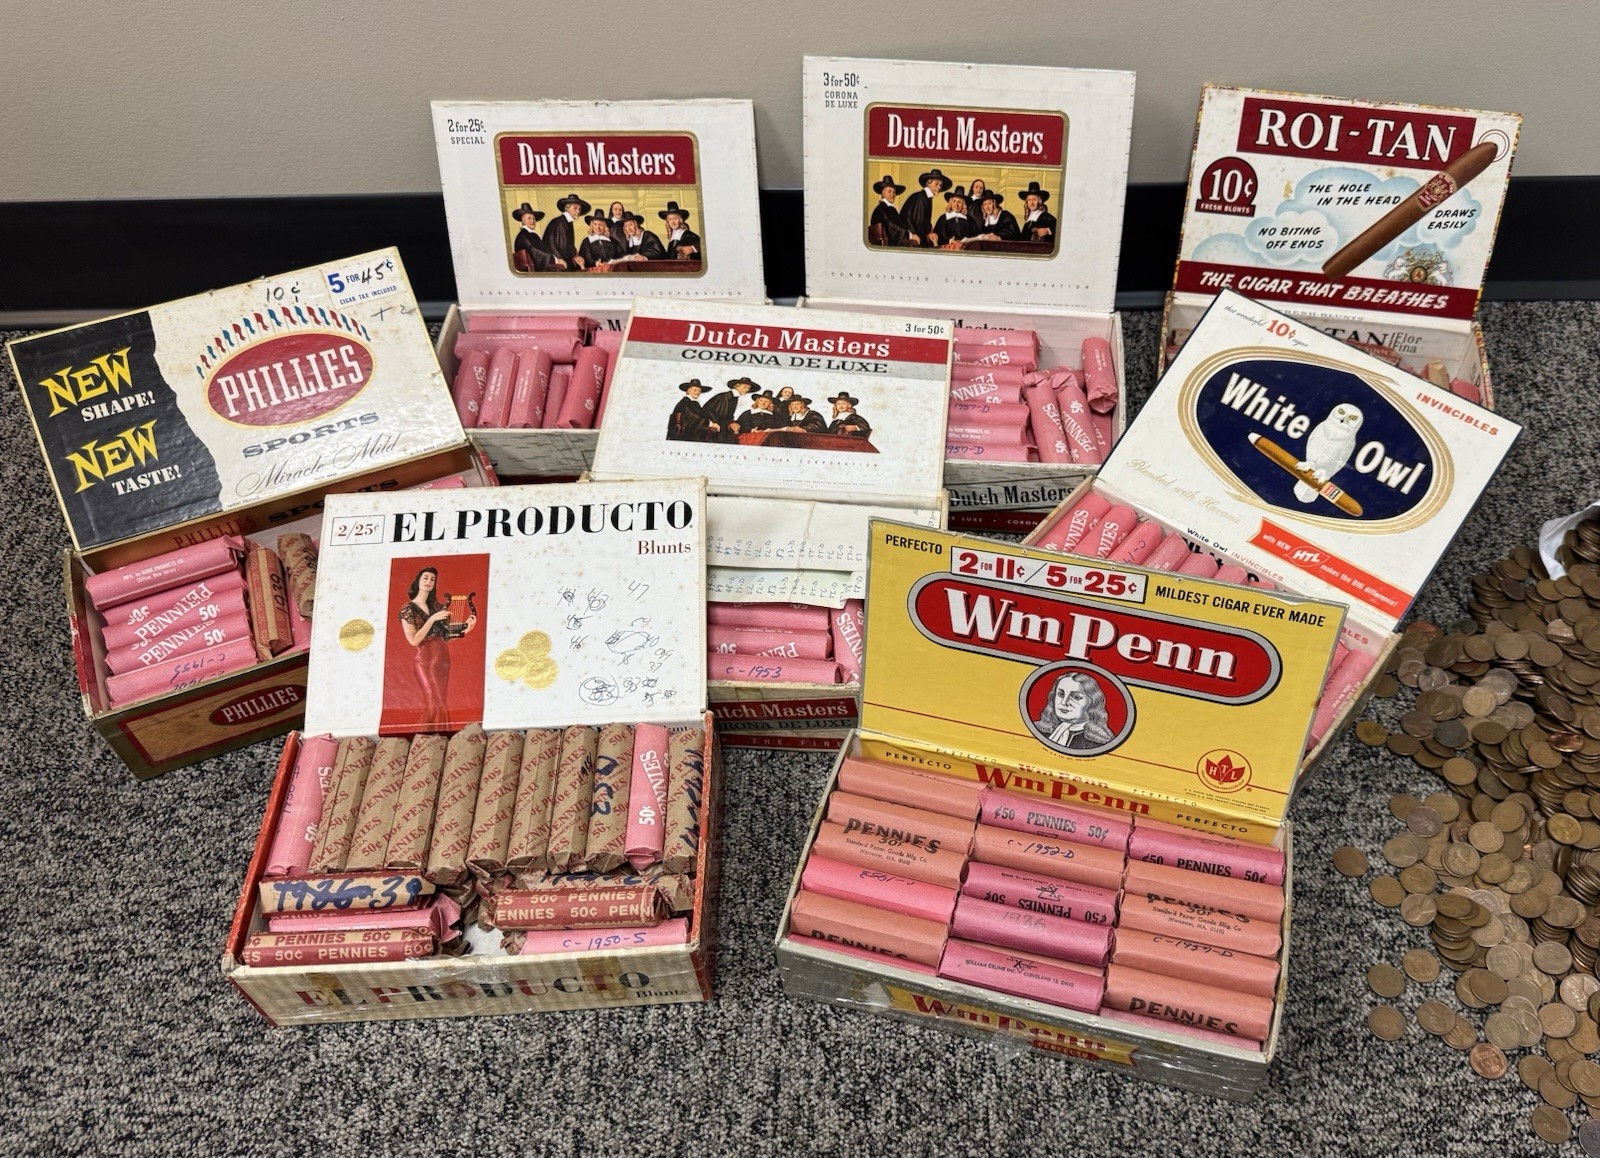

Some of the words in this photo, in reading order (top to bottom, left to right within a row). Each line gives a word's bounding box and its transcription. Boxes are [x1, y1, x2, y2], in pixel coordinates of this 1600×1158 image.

[822, 72, 830, 87] 3
[830, 76, 843, 87] for
[824, 90, 858, 100] CORONA
[825, 100, 836, 108] DE
[838, 100, 858, 109] LUXE
[447, 118, 454, 134] 2
[455, 121, 468, 134] for
[887, 113, 950, 151] Dutch
[955, 117, 1044, 155] Masters
[450, 136, 486, 145] SPECIAL
[517, 142, 584, 177] Dutch
[586, 142, 676, 177] Masters
[1208, 168, 1254, 202] 10¢
[1308, 184, 1333, 193] THE
[1338, 183, 1372, 193] HOLE
[1200, 202, 1224, 211] FRESH
[1226, 204, 1250, 214] BLUNTS
[1317, 196, 1332, 206] IN
[1336, 196, 1358, 206] THE
[1364, 196, 1401, 206] HEAD
[1435, 208, 1477, 218] DRAWS
[1258, 227, 1276, 236] NO
[1280, 226, 1322, 236] BITING
[1428, 220, 1468, 230] EASILY
[1266, 240, 1286, 250] OFF
[1290, 239, 1324, 250] ENDS
[327, 273, 345, 294] 5
[346, 274, 360, 284] FOR
[831, 272, 930, 282] CONSOLIDATED
[998, 281, 1091, 290] CORPORATION
[1199, 271, 1232, 288] THE
[1237, 277, 1294, 295] CIGAR
[1298, 282, 1340, 300] THAT
[1346, 285, 1450, 310] BREATHES
[339, 296, 356, 305] CIGAR
[359, 292, 370, 300] TAX
[371, 285, 398, 297] INCLUDED
[906, 322, 912, 333] 3
[912, 324, 926, 334] for
[927, 325, 944, 336] 50¢
[1266, 319, 1297, 340] 10¢
[685, 324, 770, 349] Dutch
[779, 330, 890, 358] Masters
[681, 349, 780, 366] CORONA
[790, 356, 821, 368] DE
[826, 360, 888, 374] LUXE
[38, 346, 133, 418] NEW
[216, 343, 364, 418] PHILLIES
[80, 390, 156, 422] SHAPE!
[1416, 392, 1499, 438] INVINCIBLES
[242, 412, 380, 459] SPORTS
[1220, 372, 1310, 440] White
[1354, 441, 1425, 494] Owl
[64, 419, 158, 493] NEW
[235, 456, 326, 498] Miracle
[333, 433, 402, 470] Mild
[662, 450, 748, 460] CONSOLIDATED
[757, 456, 790, 464] CIGAR
[800, 459, 878, 468] CORPORATION
[112, 464, 182, 496] TASTE!
[1126, 458, 1174, 488] Blended
[1174, 486, 1200, 500] with
[1004, 484, 1075, 506] Masters
[173, 516, 256, 549] PHILLIES
[337, 522, 380, 542] 2/25¢
[390, 512, 445, 544] EL
[453, 500, 692, 540] PRODUCTO
[636, 540, 692, 556] Blunts
[885, 534, 943, 556] PERFECTO
[1187, 528, 1210, 544] White
[1212, 540, 1229, 553] Owl
[1230, 551, 1284, 582] INVINCIBLES
[958, 552, 978, 576] 2
[980, 562, 993, 572] FOR
[1046, 566, 1068, 588] 5
[1070, 575, 1083, 586] FOR
[1084, 570, 1138, 596] 25¢
[1262, 534, 1276, 544] with
[1276, 540, 1291, 551] NEW
[1292, 550, 1321, 564] HTL
[1320, 564, 1340, 578] makes
[1340, 574, 1352, 582] the
[1351, 578, 1365, 590] BIG
[1364, 585, 1399, 608] difference!
[1155, 586, 1210, 606] MILDEST
[1212, 595, 1250, 614] CIGAR
[1252, 602, 1286, 620] EVER
[1288, 608, 1326, 628] MADE
[221, 686, 299, 724] PHILLIES
[760, 702, 849, 719] Masters
[776, 720, 804, 730] DE
[806, 718, 852, 728] LUXE
[752, 738, 784, 746] THE
[886, 751, 952, 770] PERFECTO
[1026, 811, 1078, 834] PENNIES
[1176, 813, 1248, 833] PERFECTO
[844, 817, 941, 854] PENNIES
[1176, 858, 1232, 878] PENNIES
[568, 890, 636, 902] PENNIES
[497, 907, 556, 921] ENNIES
[570, 906, 598, 918] 50¢
[1018, 898, 1072, 920] PENNIES
[274, 933, 346, 946] PENNIES
[362, 932, 390, 942] 50¢
[274, 950, 303, 962] 50¢
[318, 946, 388, 960] PENNIES
[1023, 972, 1052, 982] CLEVELAND
[1060, 980, 1075, 988] OHIO
[636, 988, 688, 999] Blunts
[1128, 996, 1239, 1035] PENNIES
